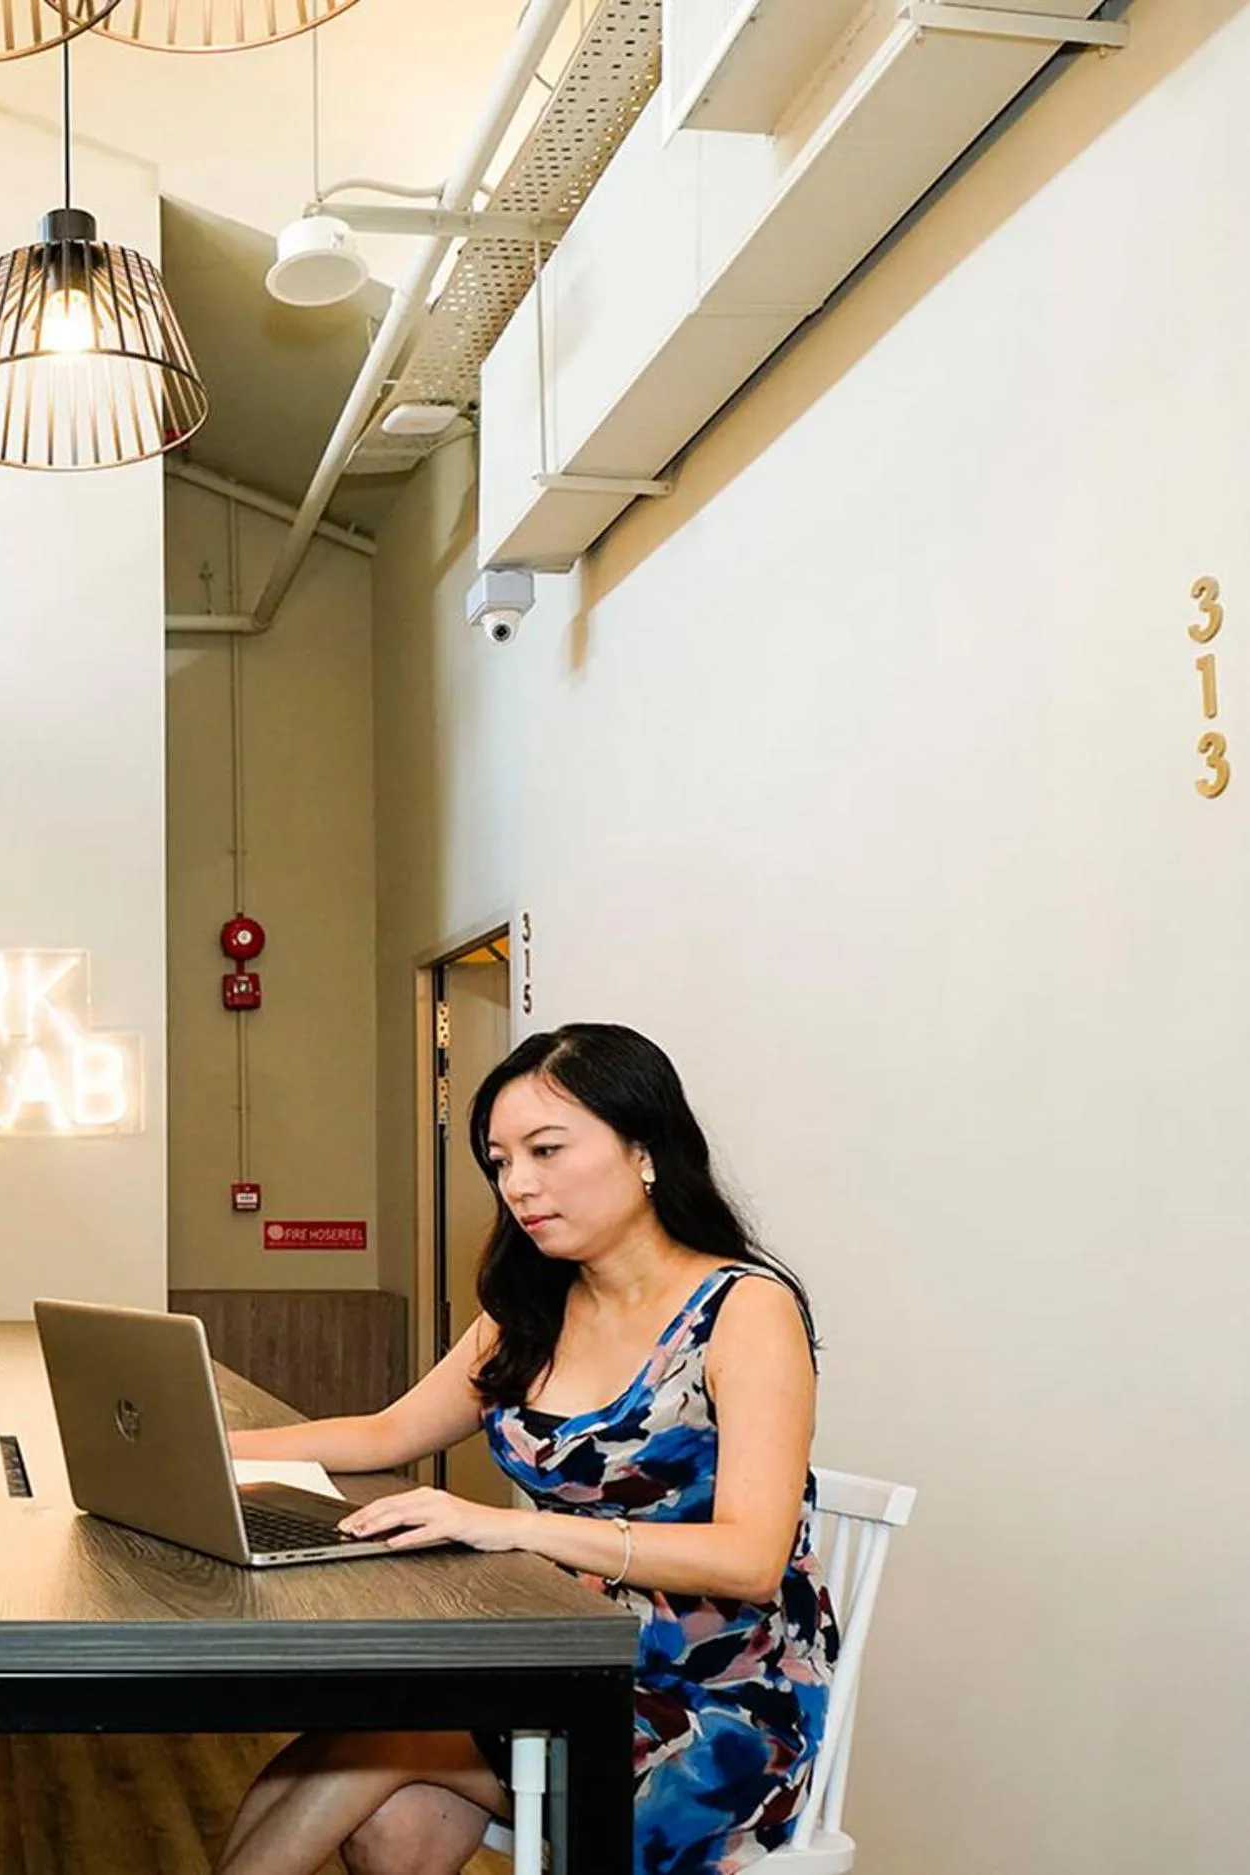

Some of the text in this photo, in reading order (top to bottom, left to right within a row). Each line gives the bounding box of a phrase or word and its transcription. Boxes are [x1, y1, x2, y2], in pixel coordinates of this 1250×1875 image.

[1187, 575, 1231, 799] 313
[521, 911, 532, 1014] 315
[284, 1228, 363, 1241] FIRE HOSEREEL
